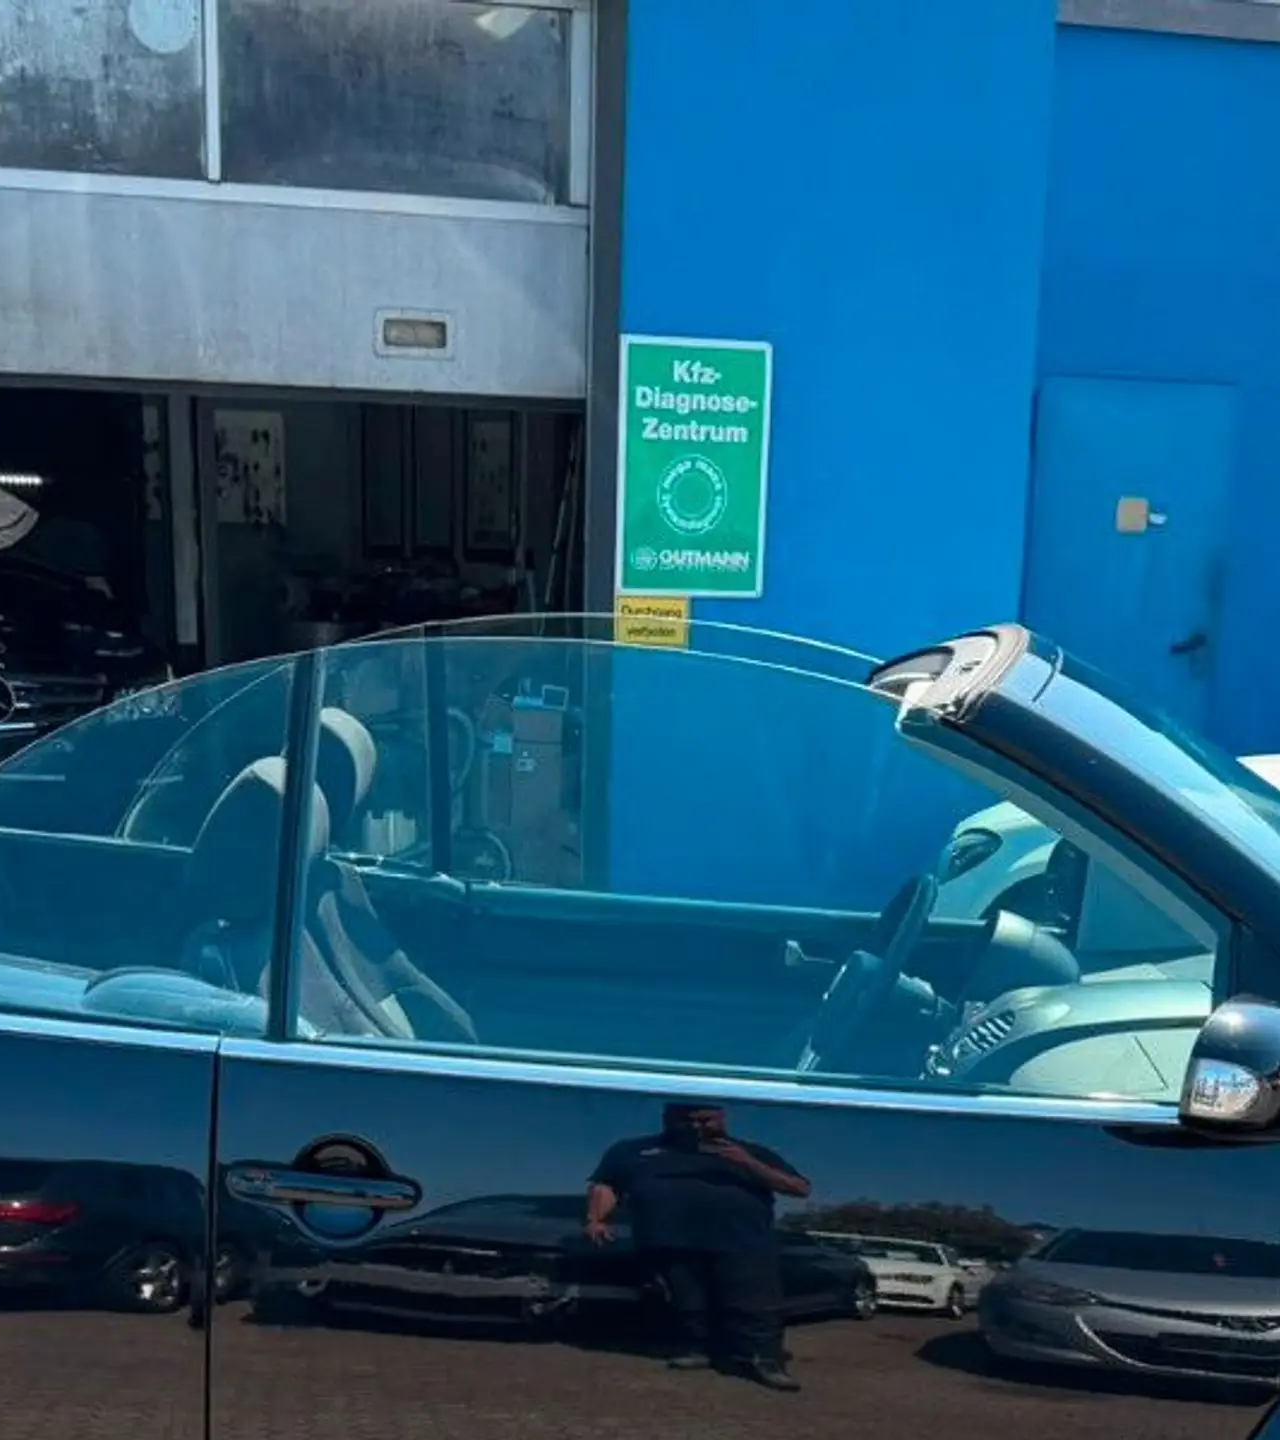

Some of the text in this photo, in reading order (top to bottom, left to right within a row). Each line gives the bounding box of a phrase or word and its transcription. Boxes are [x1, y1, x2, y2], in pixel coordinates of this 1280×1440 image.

[673, 359, 722, 384] Kfz-
[635, 385, 758, 414] Diagnose-
[642, 417, 748, 443] Zentrum
